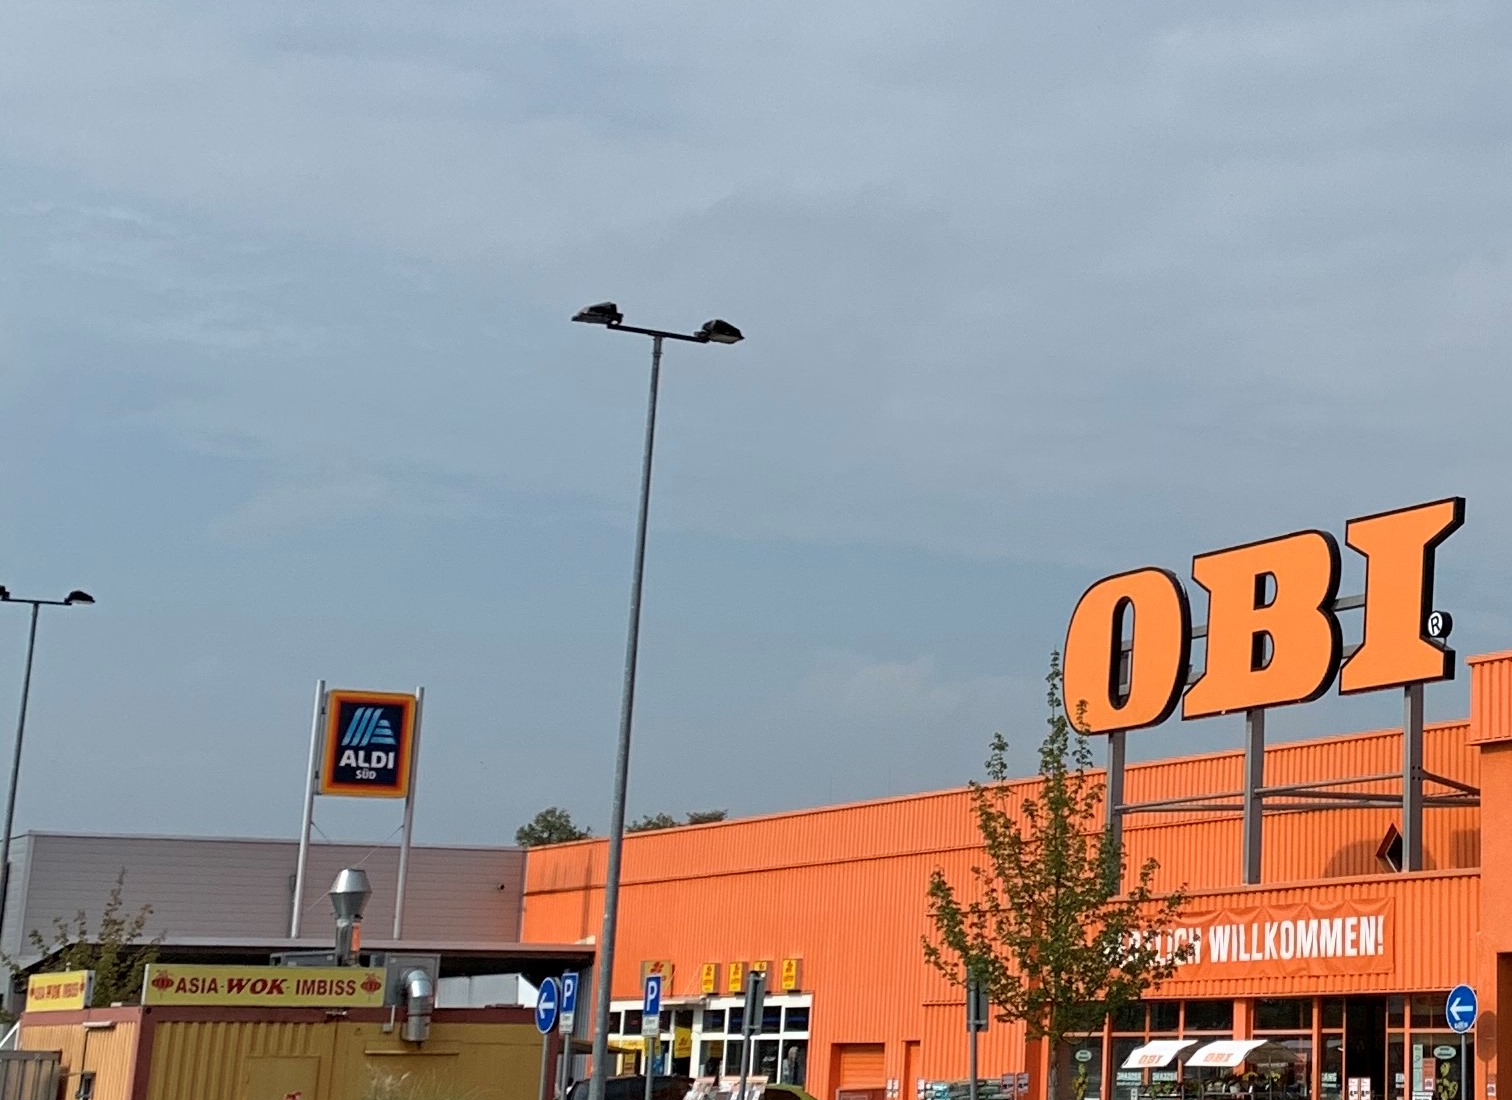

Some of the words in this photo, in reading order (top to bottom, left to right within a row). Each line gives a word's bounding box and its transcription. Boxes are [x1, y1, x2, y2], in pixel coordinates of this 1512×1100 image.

[1063, 496, 1466, 735] OBI
[339, 749, 396, 769] ALDI
[355, 768, 377, 779] SÜD
[1208, 915, 1384, 964] WILLKOMMEN!
[174, 977, 219, 994] ASIA
[225, 978, 288, 995] WOK
[295, 979, 357, 996] IMBISS
[562, 979, 575, 1008] P
[646, 981, 658, 1012] P
[1137, 1054, 1164, 1065] OBI
[1203, 1052, 1234, 1063] OBI
